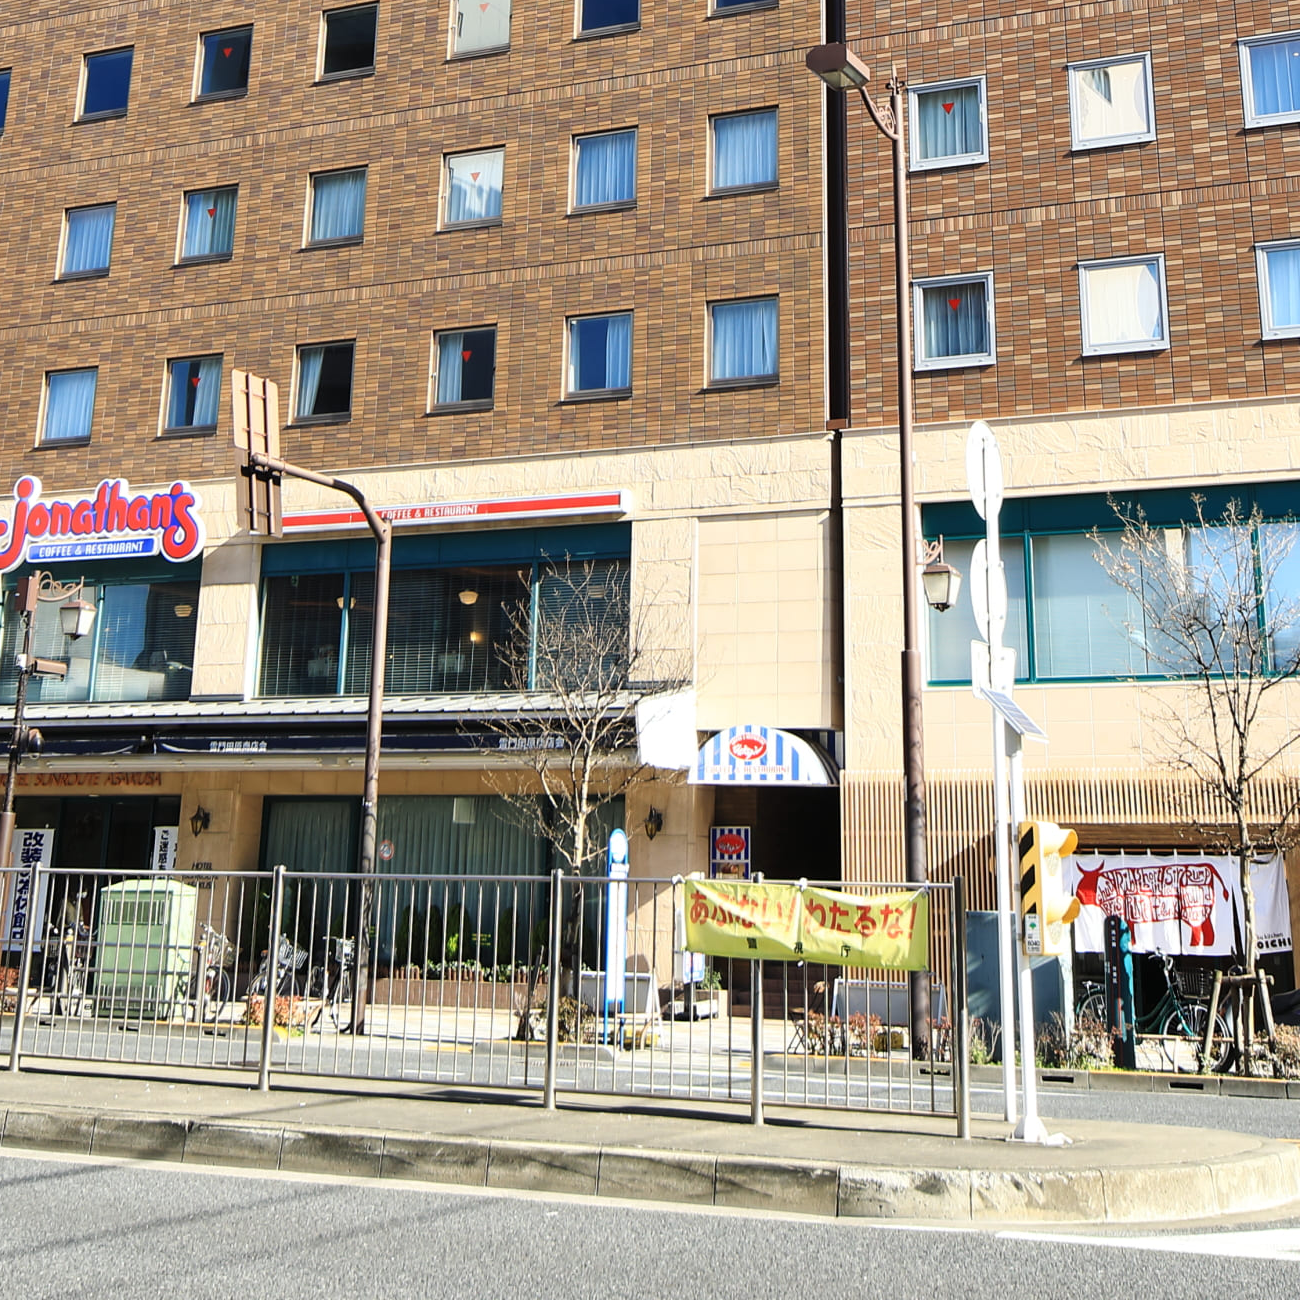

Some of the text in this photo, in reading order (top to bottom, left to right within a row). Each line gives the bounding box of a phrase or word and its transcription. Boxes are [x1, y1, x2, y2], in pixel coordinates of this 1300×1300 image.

[424, 504, 479, 517] RESTAURANT
[38, 541, 145, 558] COFFEE & RESTAURANT
[1256, 937, 1292, 949] OICHI
